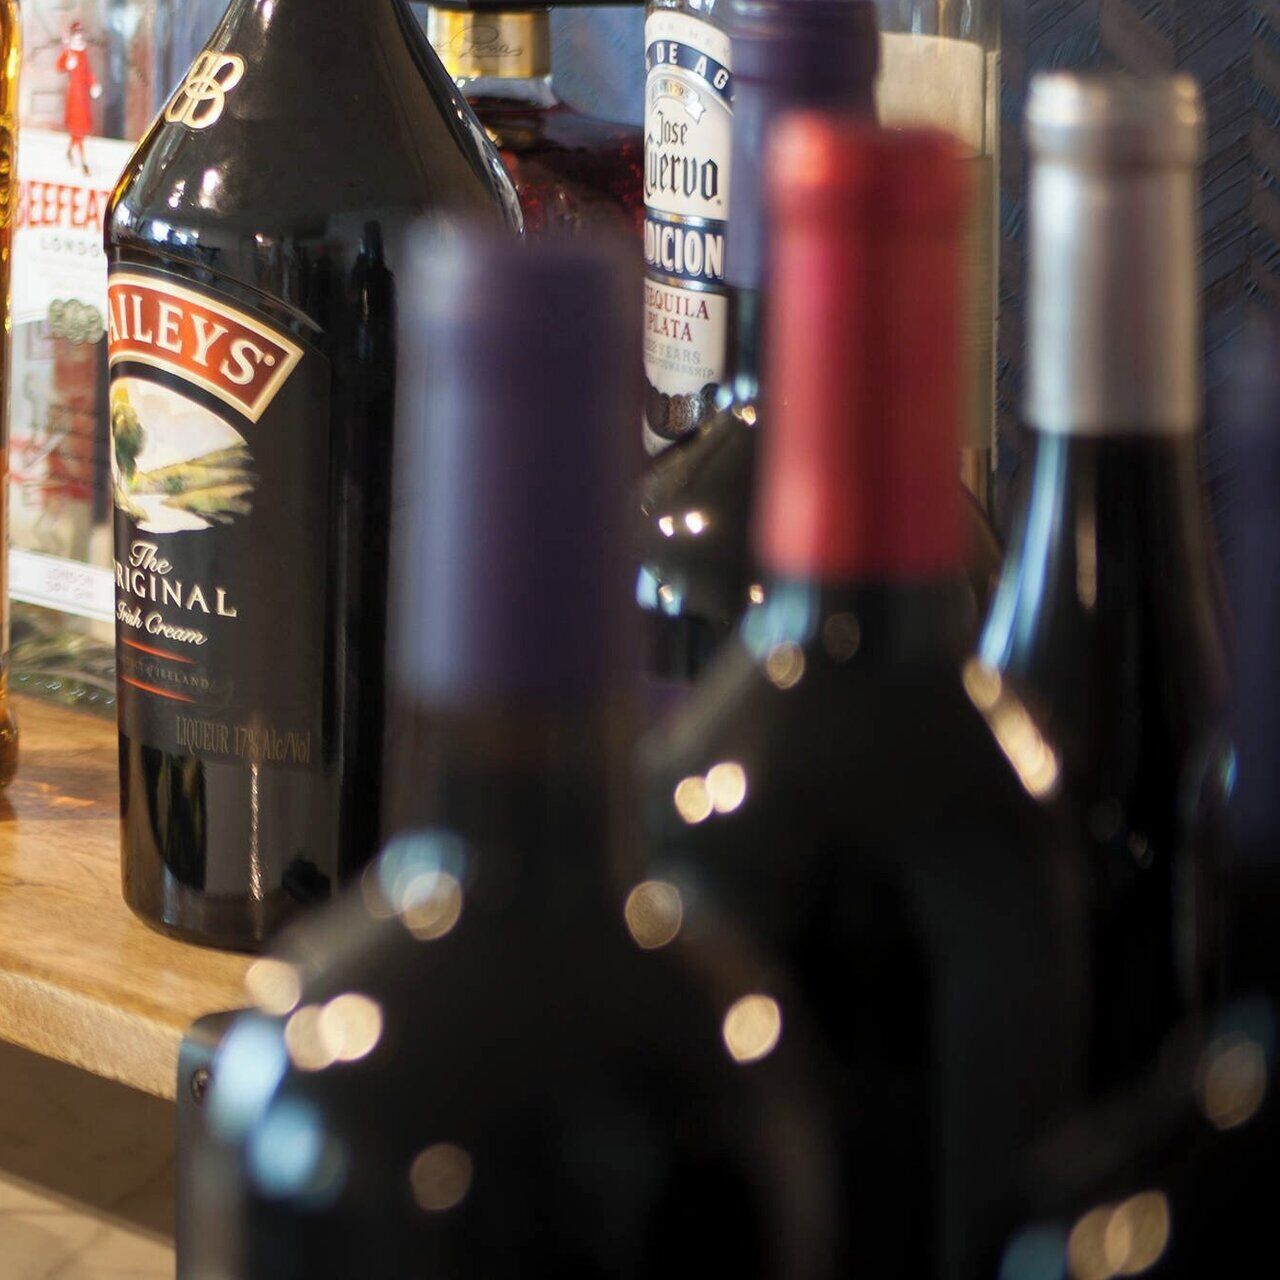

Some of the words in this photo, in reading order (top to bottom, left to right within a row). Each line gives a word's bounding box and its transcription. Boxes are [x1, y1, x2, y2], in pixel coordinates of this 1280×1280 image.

[656, 42, 679, 64] DE
[657, 110, 688, 147] Jose
[128, 540, 173, 575] The
[144, 612, 208, 646] Cream
[176, 715, 229, 755] LIQUEUR
[235, 724, 260, 759] 17%
[262, 726, 312, 765] Alc/Vol
